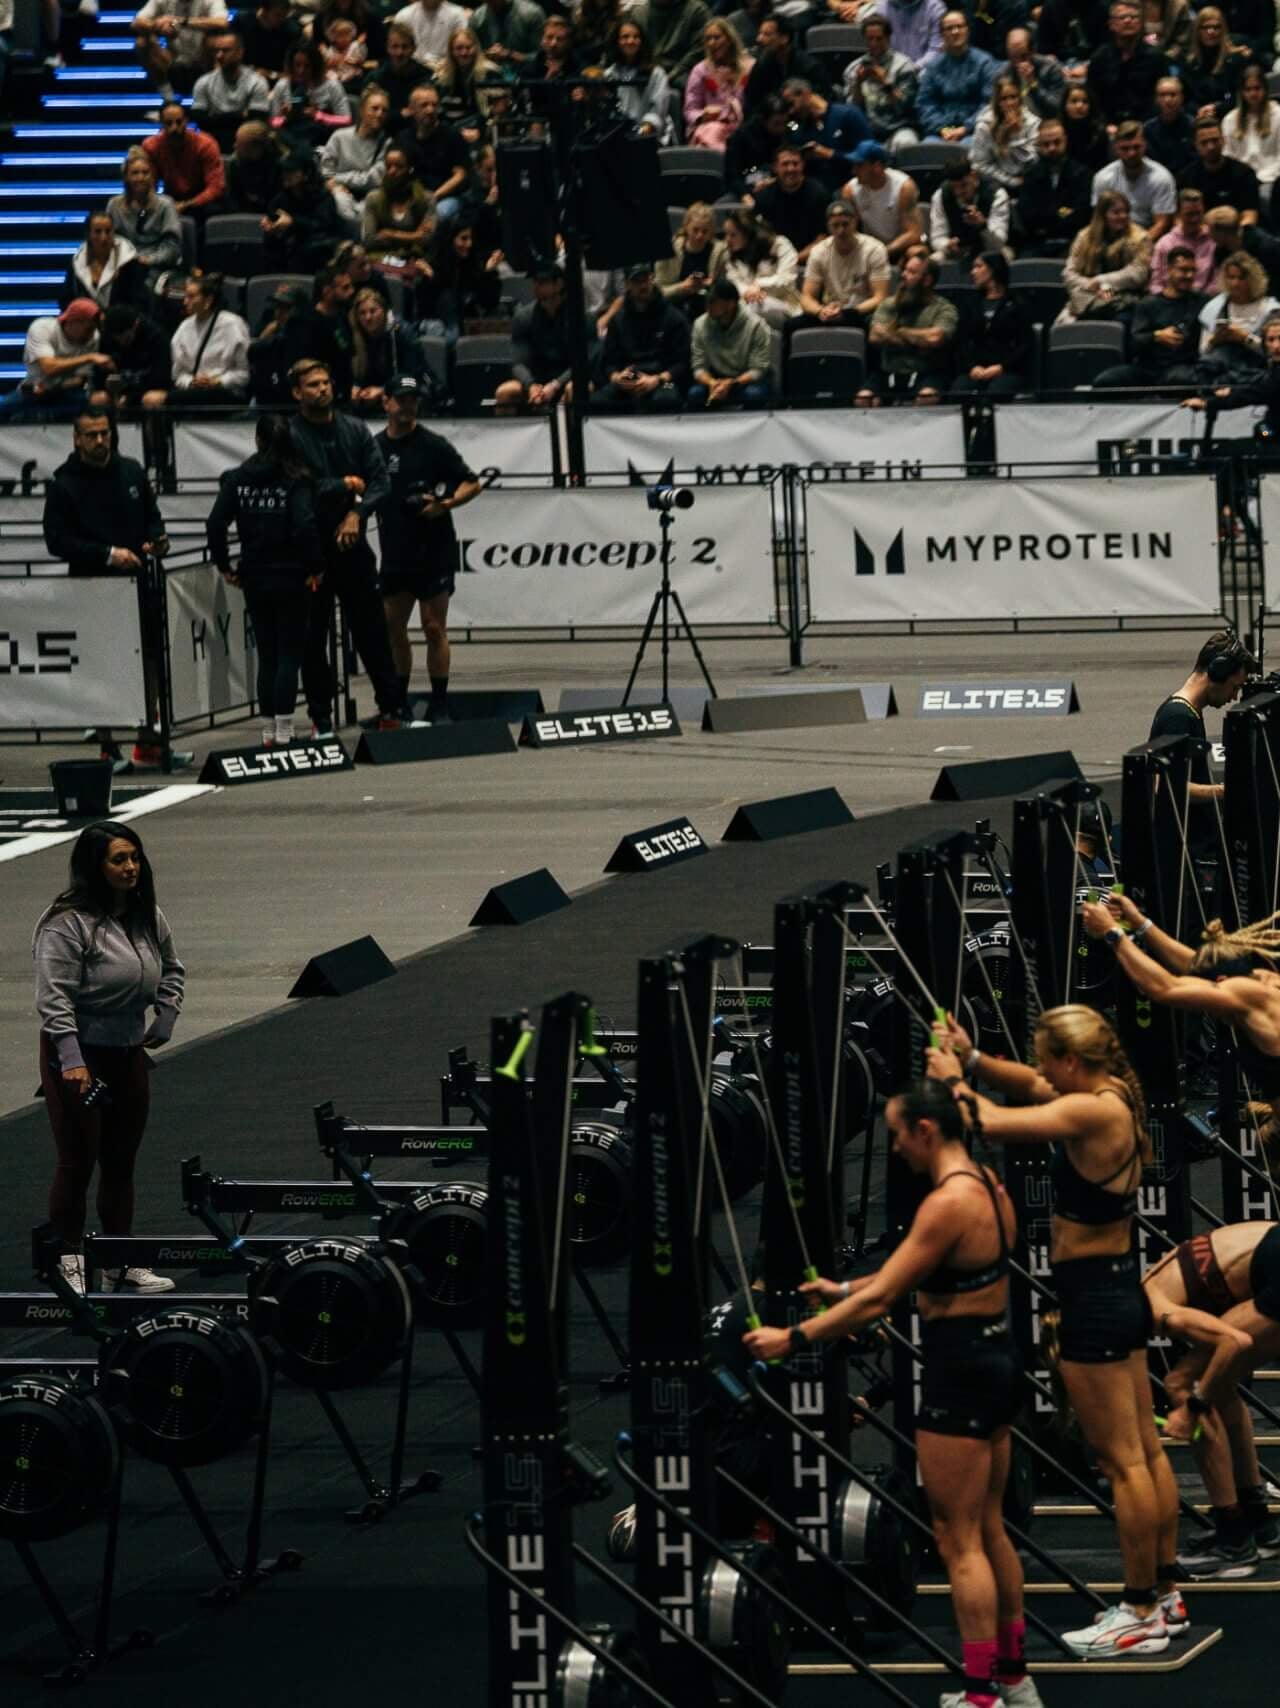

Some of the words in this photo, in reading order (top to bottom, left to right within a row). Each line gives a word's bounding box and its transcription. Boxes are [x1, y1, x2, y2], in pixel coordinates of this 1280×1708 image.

[483, 540, 677, 569] concept
[691, 537, 716, 563] 2
[926, 532, 1172, 562] MYPROTEIN
[923, 688, 1065, 710] ELITE15
[536, 709, 672, 741] ELITE15
[221, 744, 344, 778] ELITE15
[634, 825, 702, 863] ELITE15
[413, 1189, 487, 1211] ELITE
[285, 1243, 361, 1267] ELITE
[136, 1314, 214, 1338] ELITE
